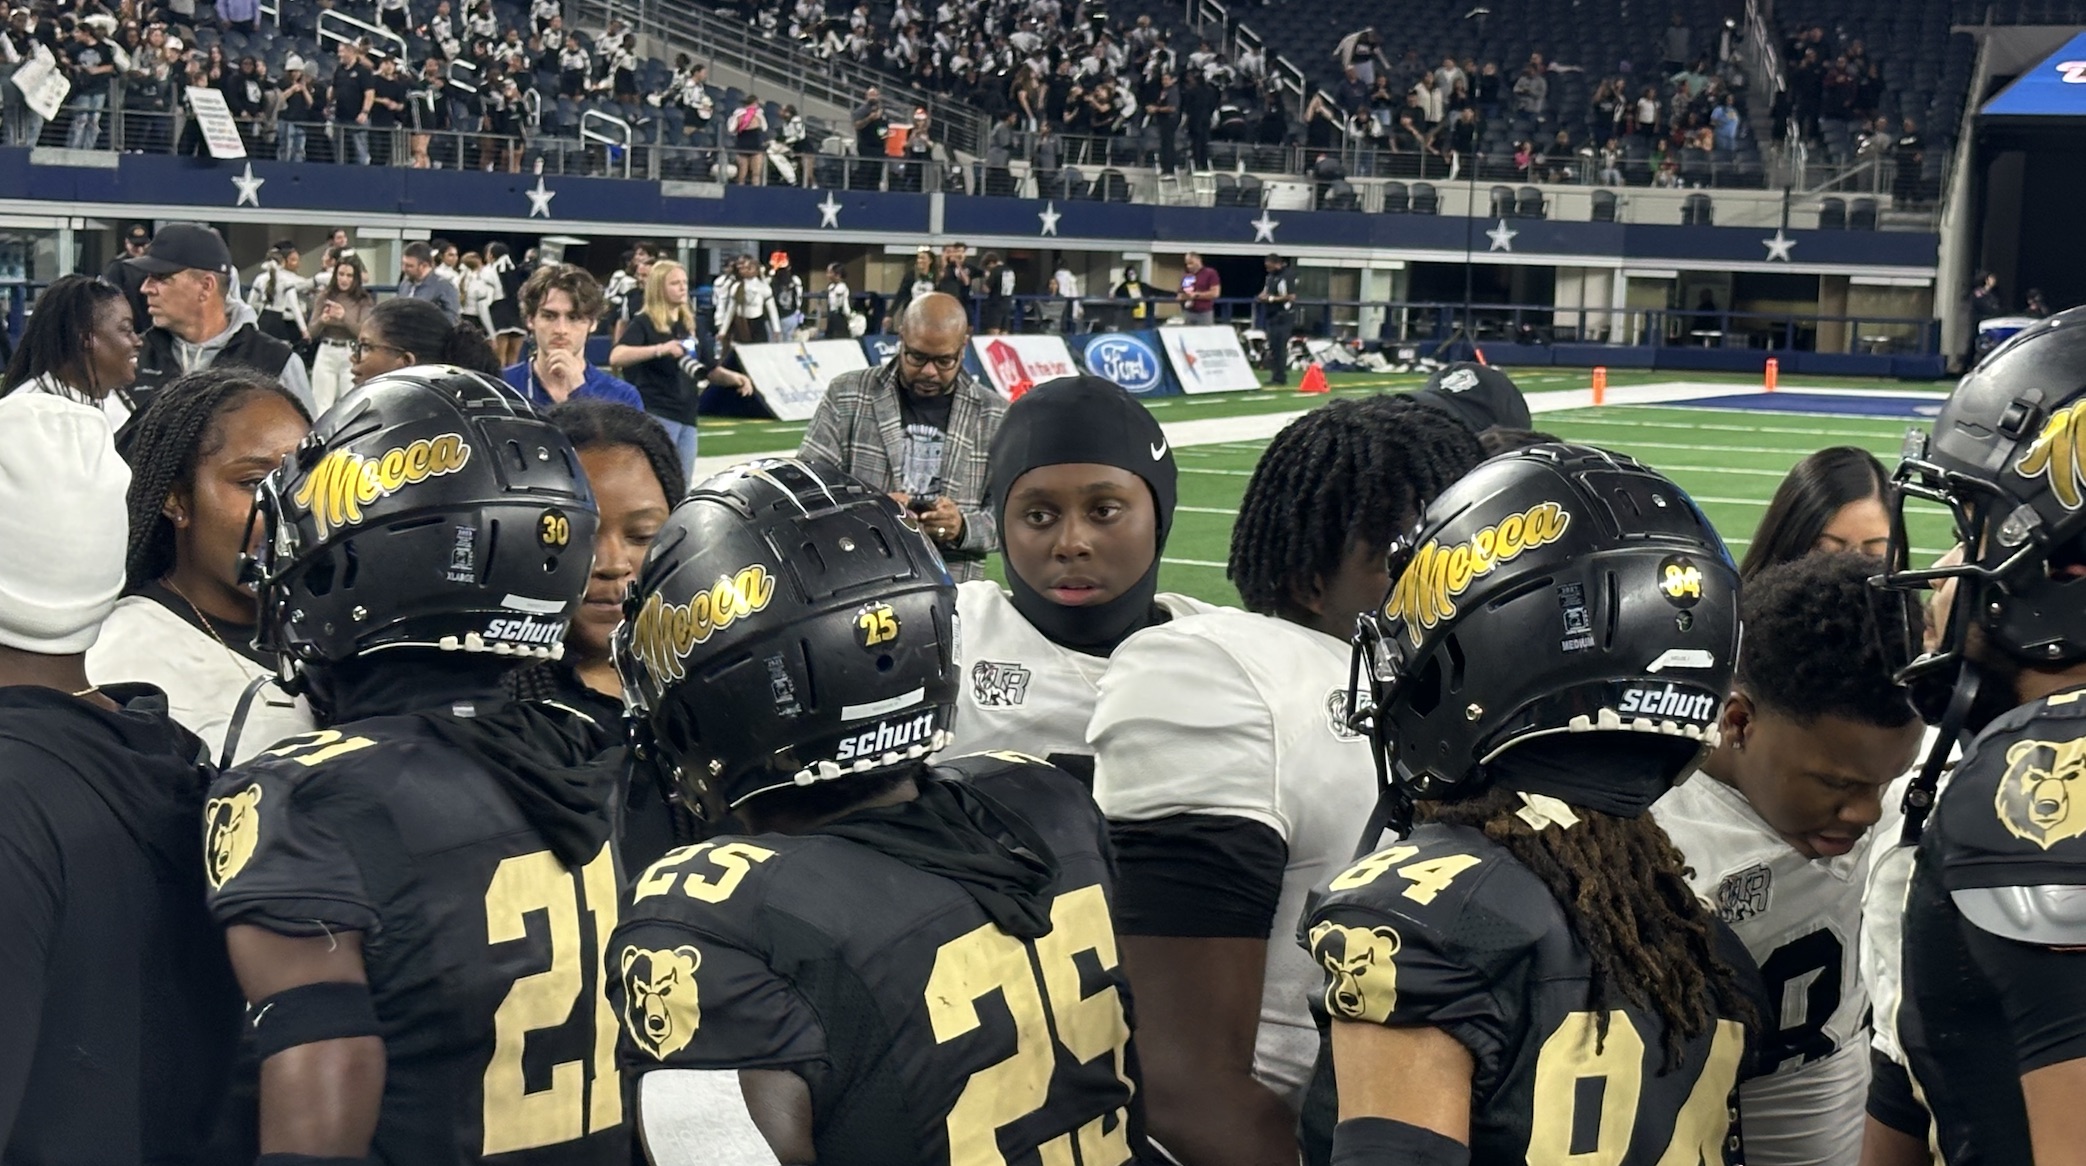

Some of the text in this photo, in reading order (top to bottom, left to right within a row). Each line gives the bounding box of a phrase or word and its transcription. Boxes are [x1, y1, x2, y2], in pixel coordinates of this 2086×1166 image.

[1100, 342, 1149, 383] Ford
[295, 433, 471, 542] Mecca
[541, 516, 570, 545] 30
[1385, 501, 1572, 649] Mecca
[1663, 565, 1703, 599] 84
[483, 615, 563, 644] schutt
[633, 564, 776, 698] Mecca
[860, 608, 899, 646] 25
[1618, 684, 1714, 721] schutt
[836, 713, 933, 761] schutt
[634, 843, 779, 905] 25
[1328, 846, 1481, 905] 84
[482, 840, 623, 1156] 21
